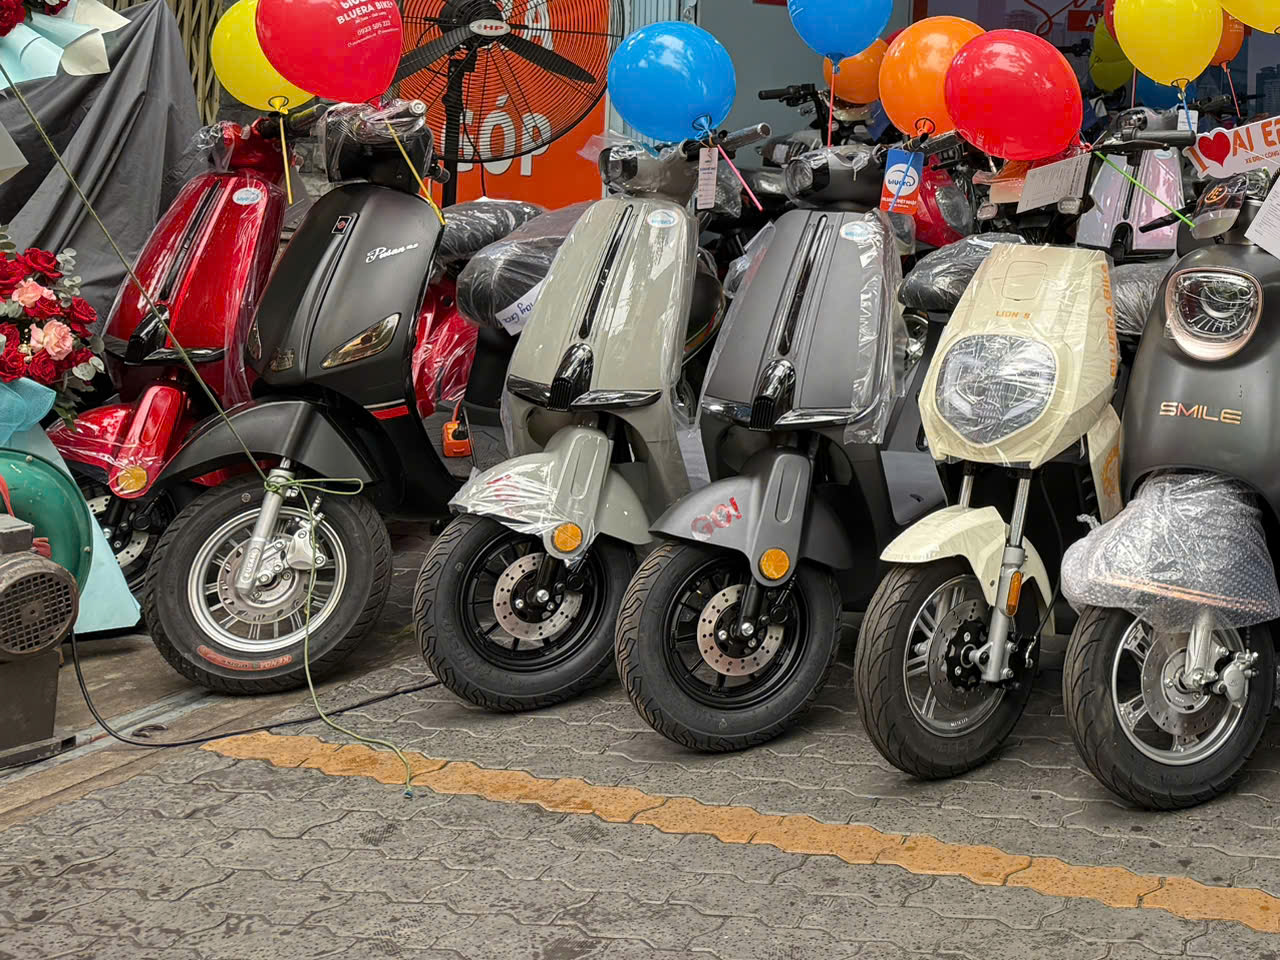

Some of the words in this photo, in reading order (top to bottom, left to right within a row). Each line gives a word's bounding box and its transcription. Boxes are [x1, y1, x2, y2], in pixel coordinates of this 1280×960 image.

[336, 5, 374, 24] BLUERA
[1232, 127, 1254, 157] AI
[1160, 402, 1242, 425] SMILE
